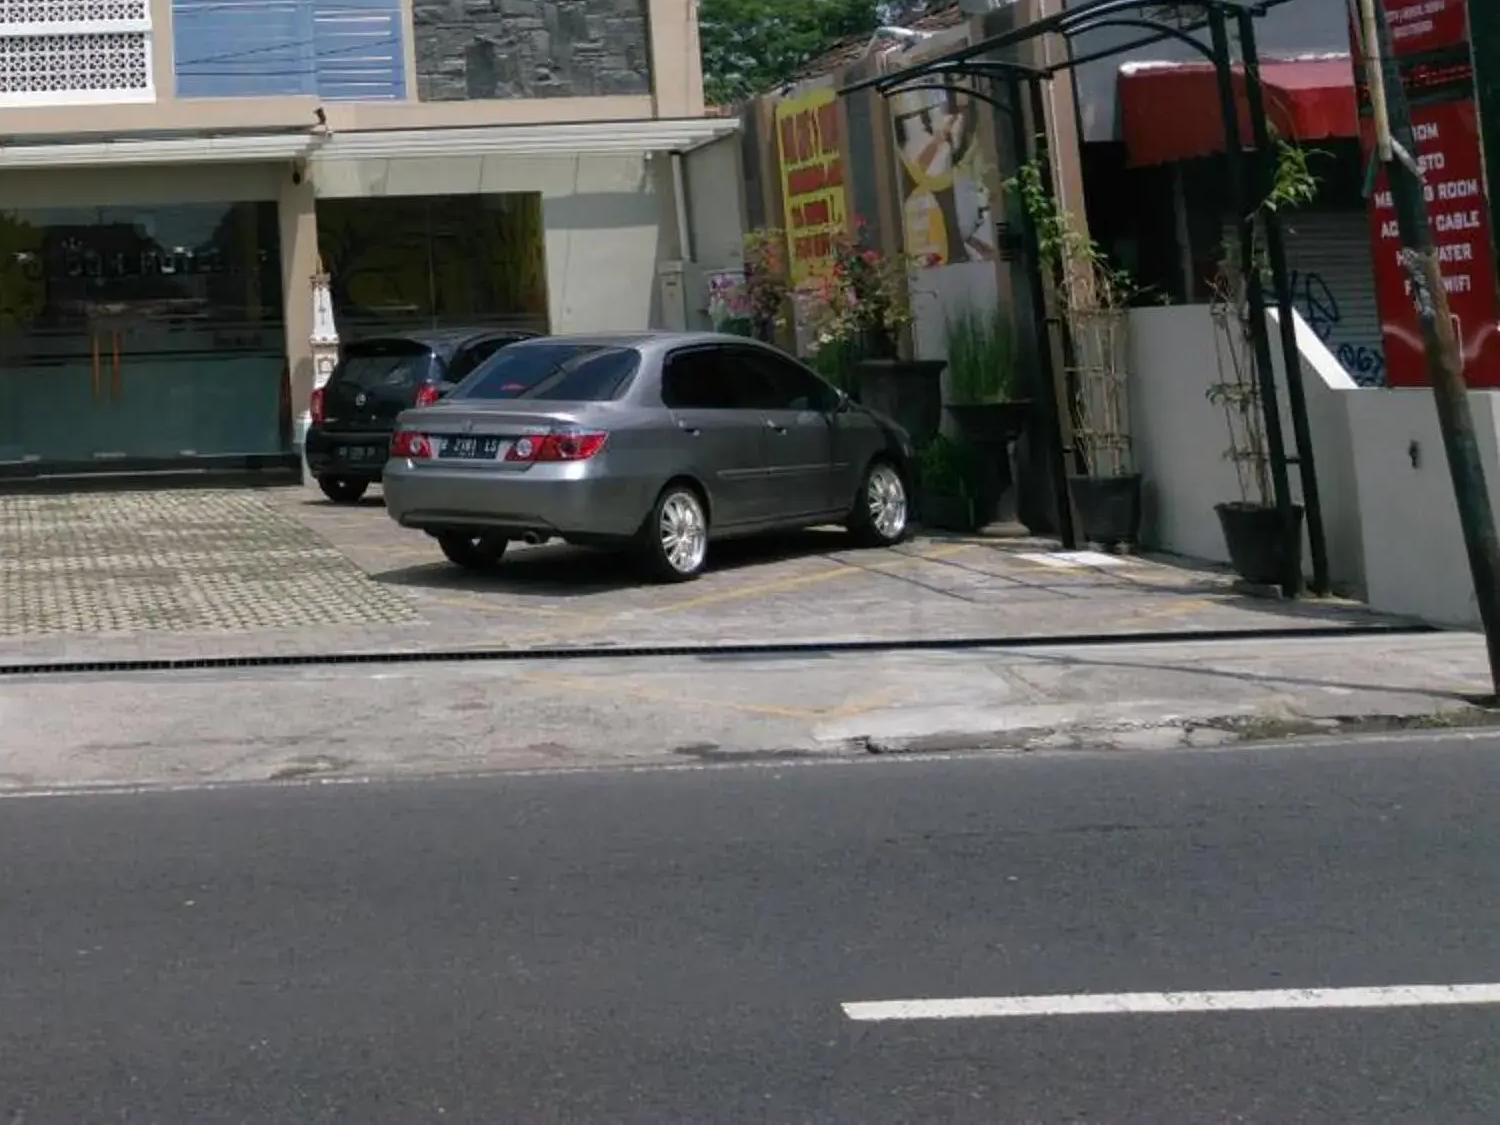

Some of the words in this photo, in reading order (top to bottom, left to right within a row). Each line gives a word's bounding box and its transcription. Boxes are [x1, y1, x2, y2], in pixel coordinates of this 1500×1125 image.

[1416, 152, 1445, 172] STO
[1437, 179, 1479, 200] ROOM
[1435, 210, 1480, 232] CABLE
[1435, 243, 1474, 263] ATER
